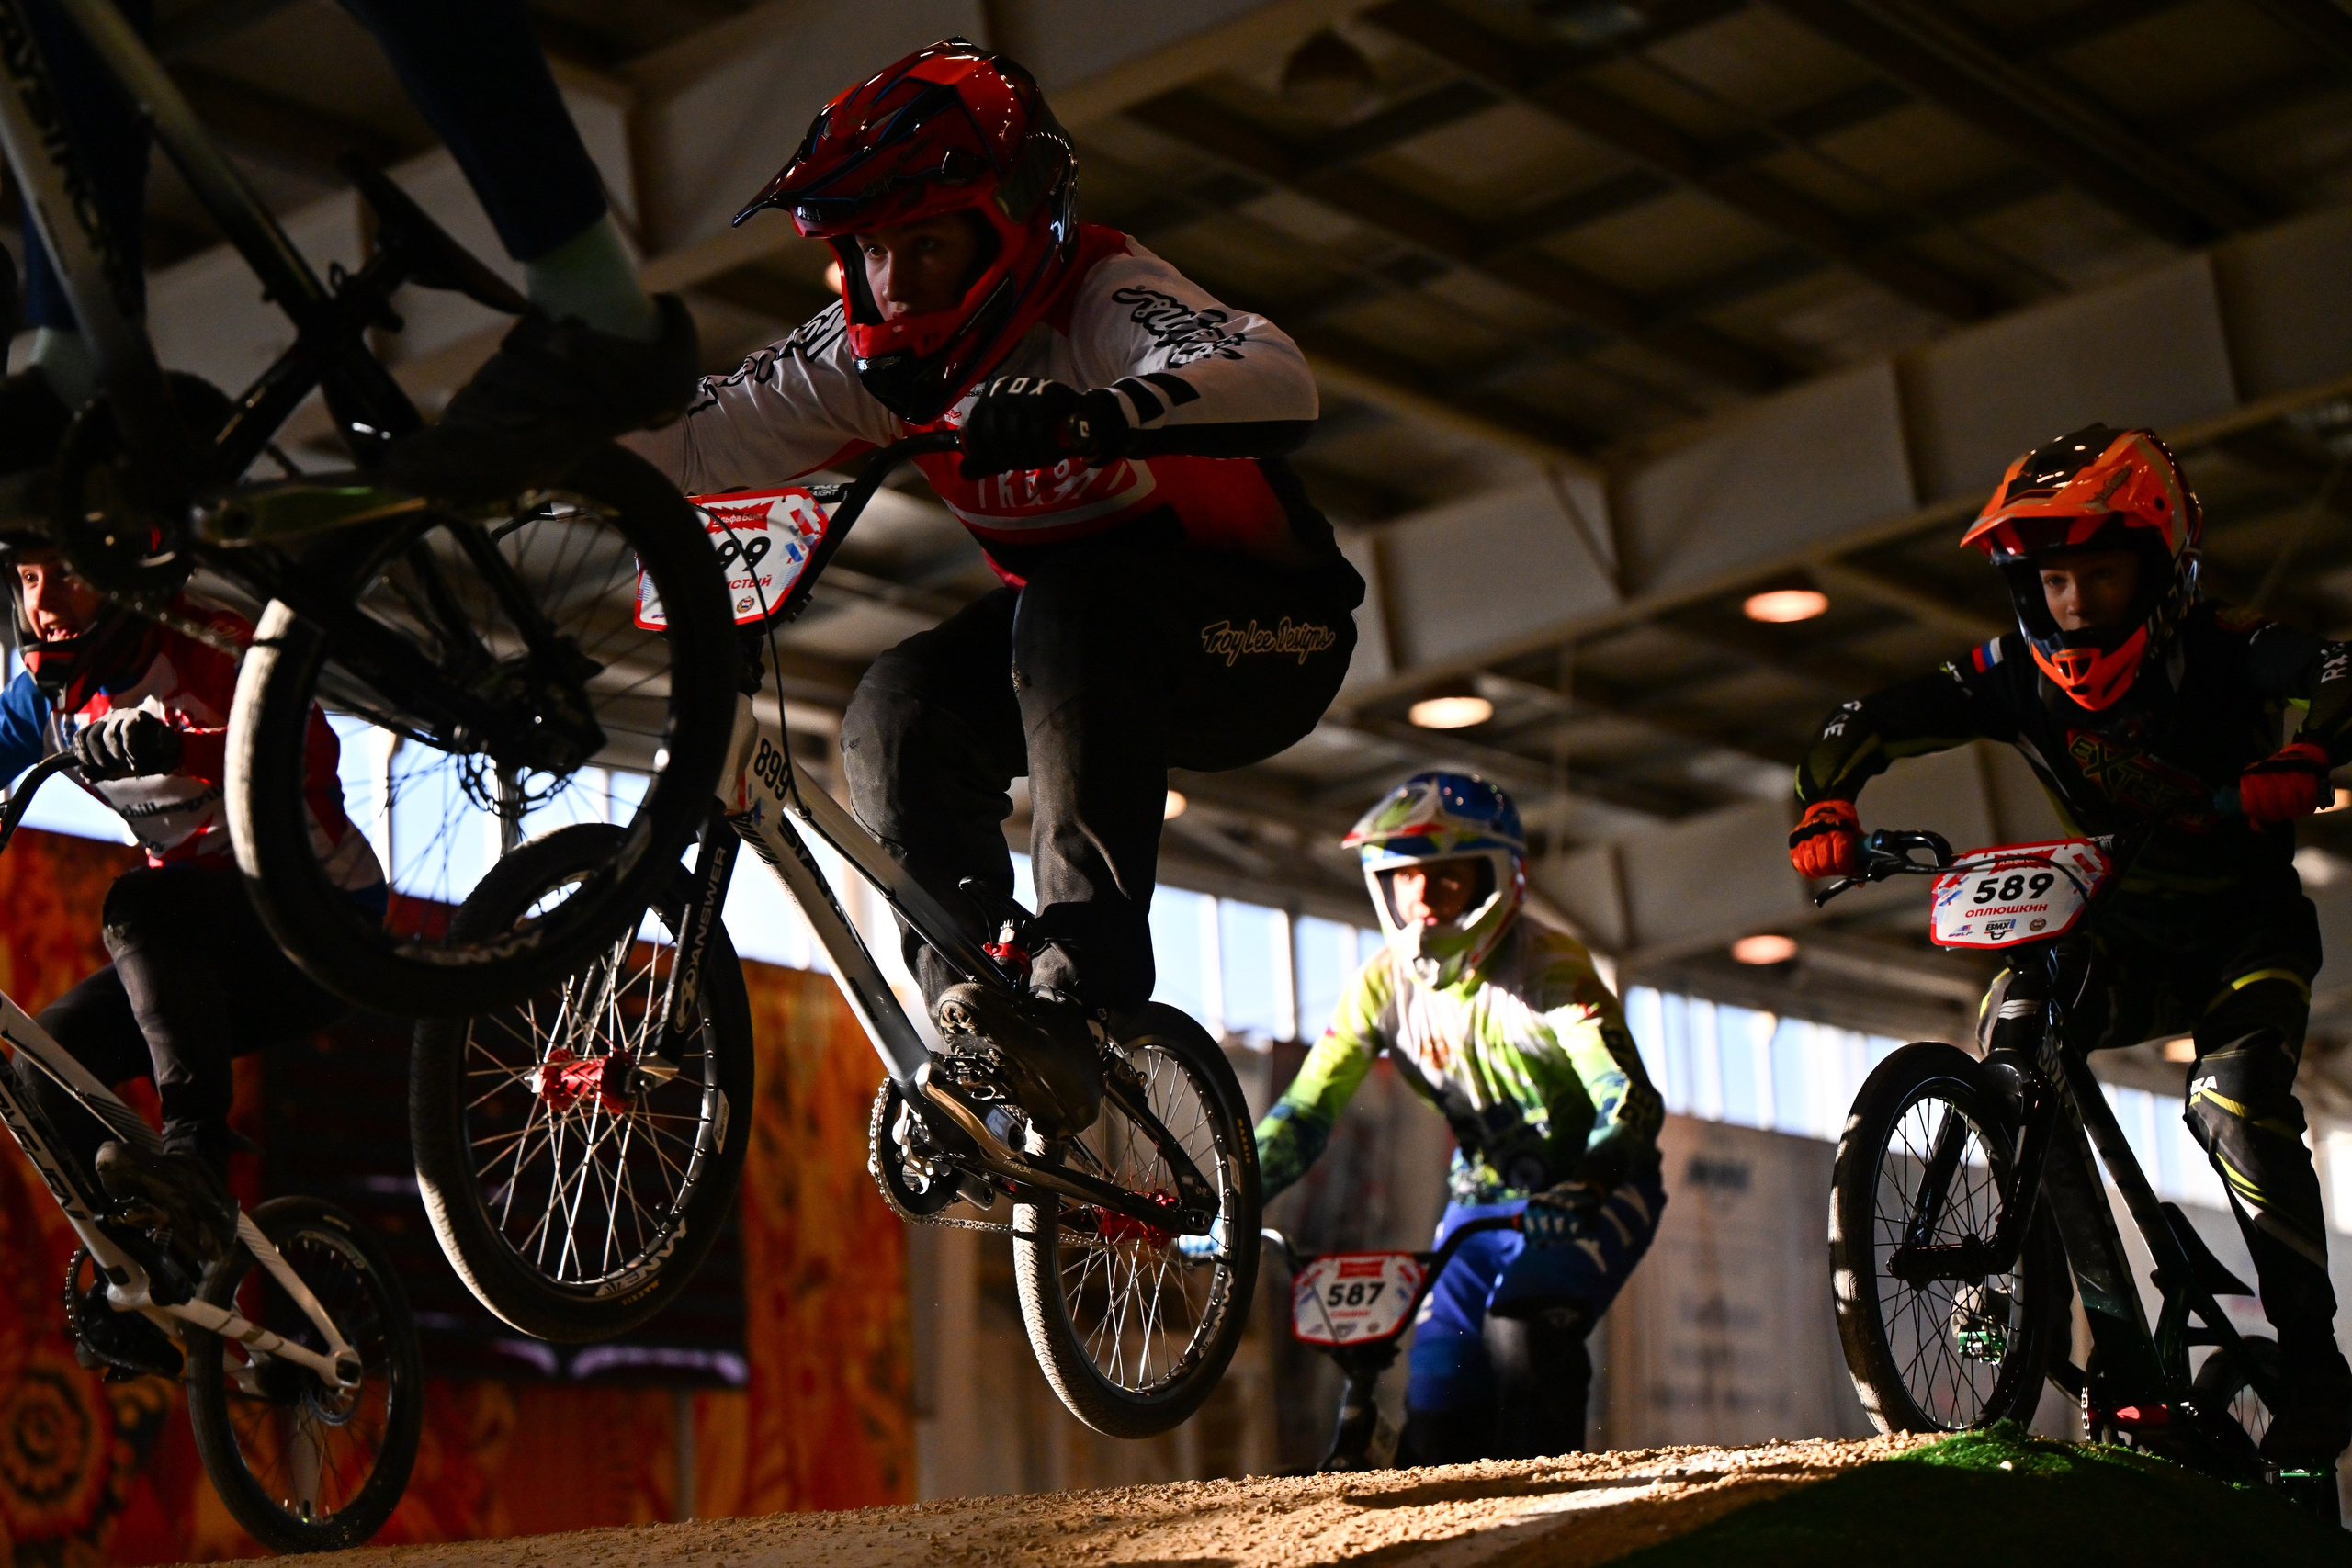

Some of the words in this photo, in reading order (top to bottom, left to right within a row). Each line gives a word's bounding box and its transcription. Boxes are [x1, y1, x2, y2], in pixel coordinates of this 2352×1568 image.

[989, 375, 1054, 397] FOX
[717, 536, 771, 571] 99
[726, 574, 773, 591] ИСТЫЙ
[1201, 619, 1246, 667] Troy
[1242, 618, 1275, 653] Lee
[1274, 615, 1336, 665] Designs
[754, 738, 792, 801] 899
[1973, 873, 2054, 904] 589
[691, 845, 728, 966] ANSWER
[1965, 903, 2048, 918] ОПЛЮШКИН
[1985, 921, 2010, 931] BMX
[1236, 1118, 1252, 1165] MAXXIS
[1327, 1282, 1386, 1307] 587
